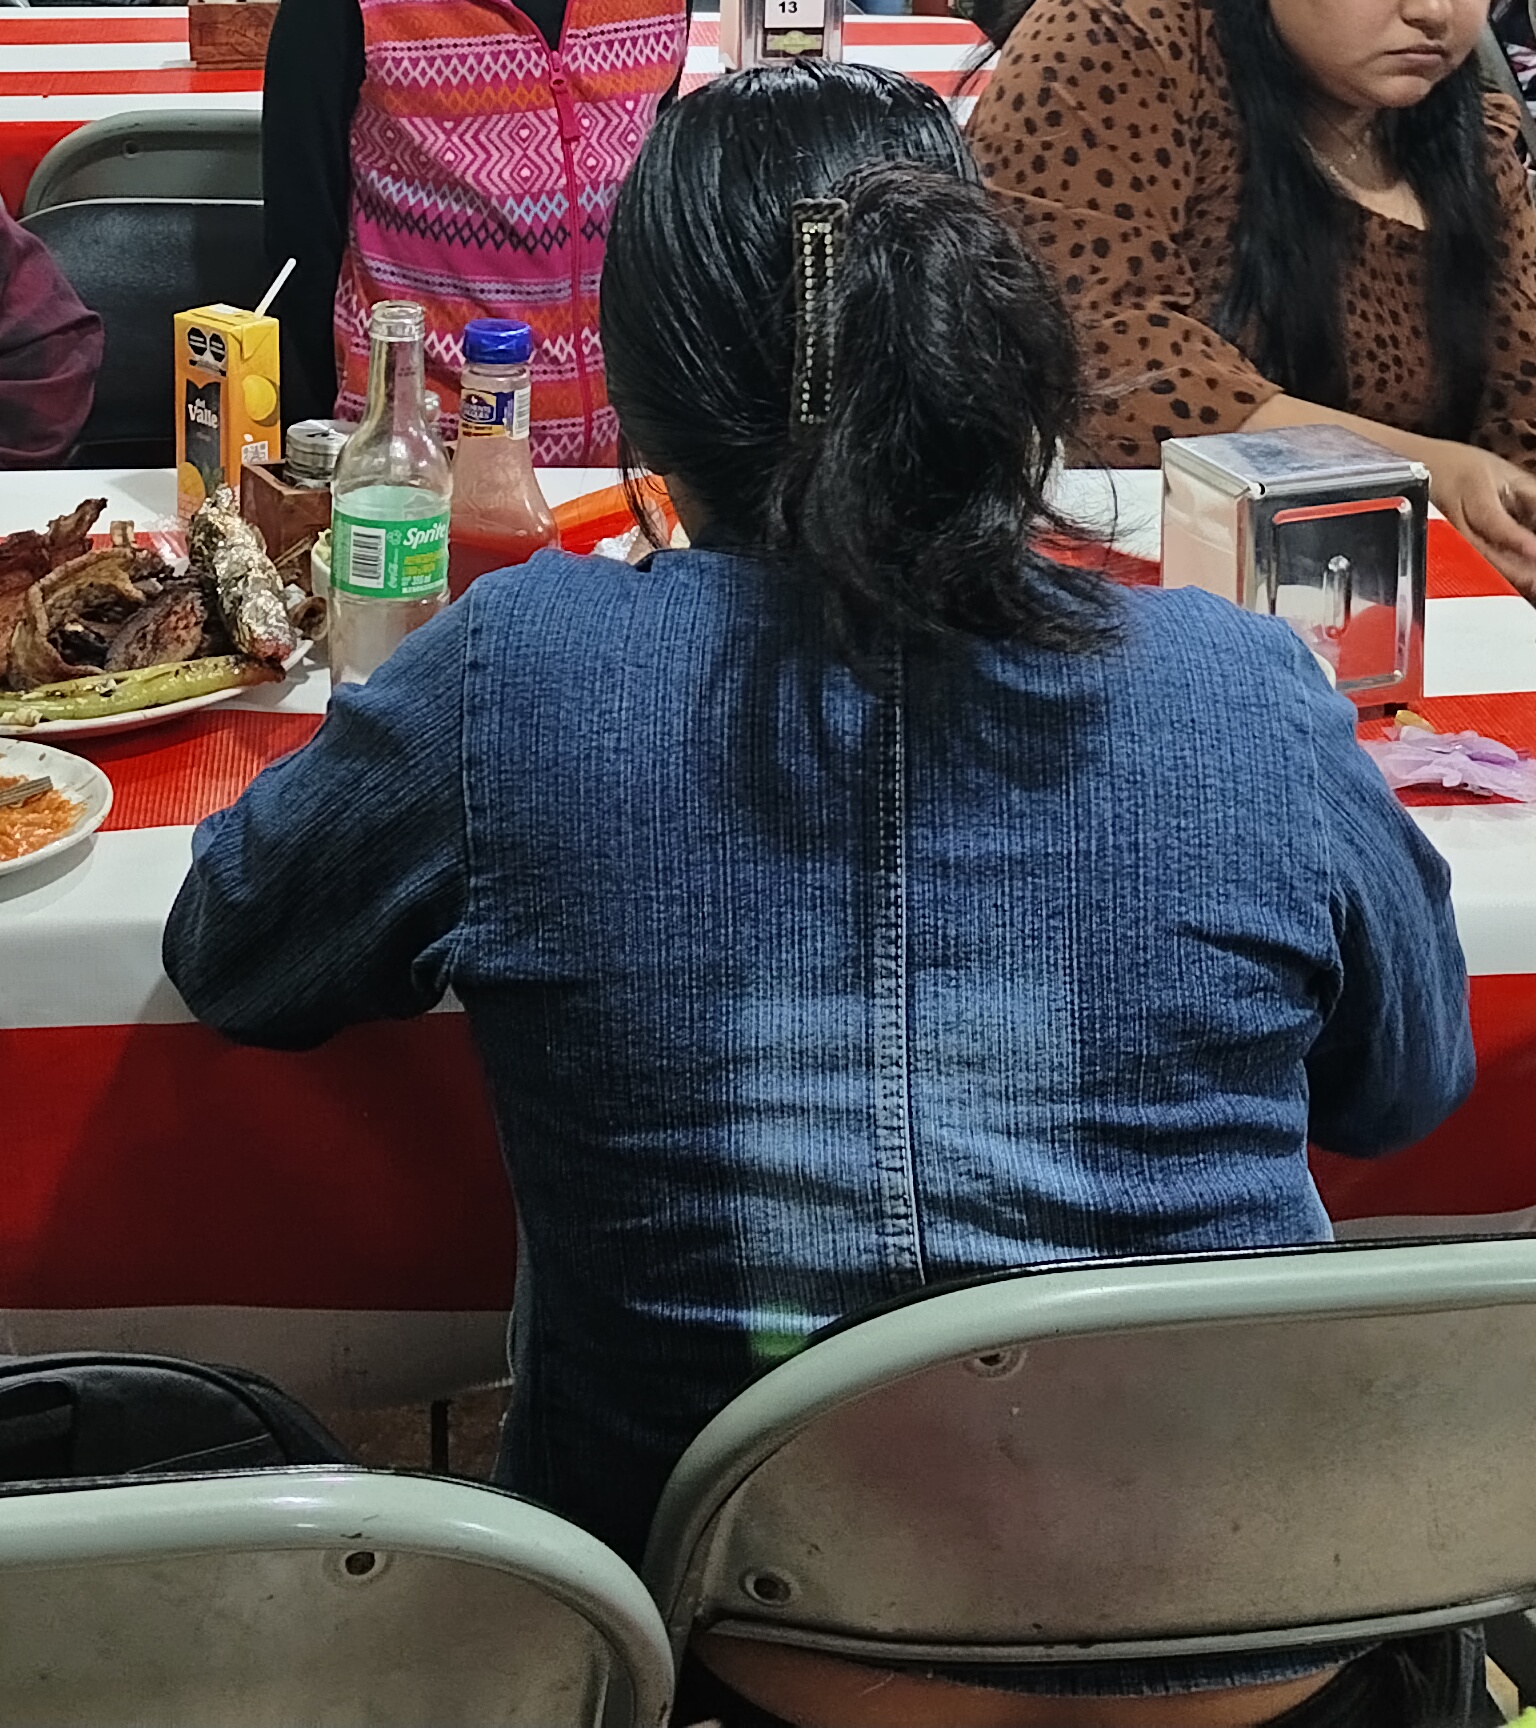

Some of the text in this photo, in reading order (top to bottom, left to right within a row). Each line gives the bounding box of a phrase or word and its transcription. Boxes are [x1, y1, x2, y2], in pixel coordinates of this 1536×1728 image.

[777, 0, 799, 15] 13
[187, 403, 219, 430] Valle
[402, 521, 447, 551] Sprite
